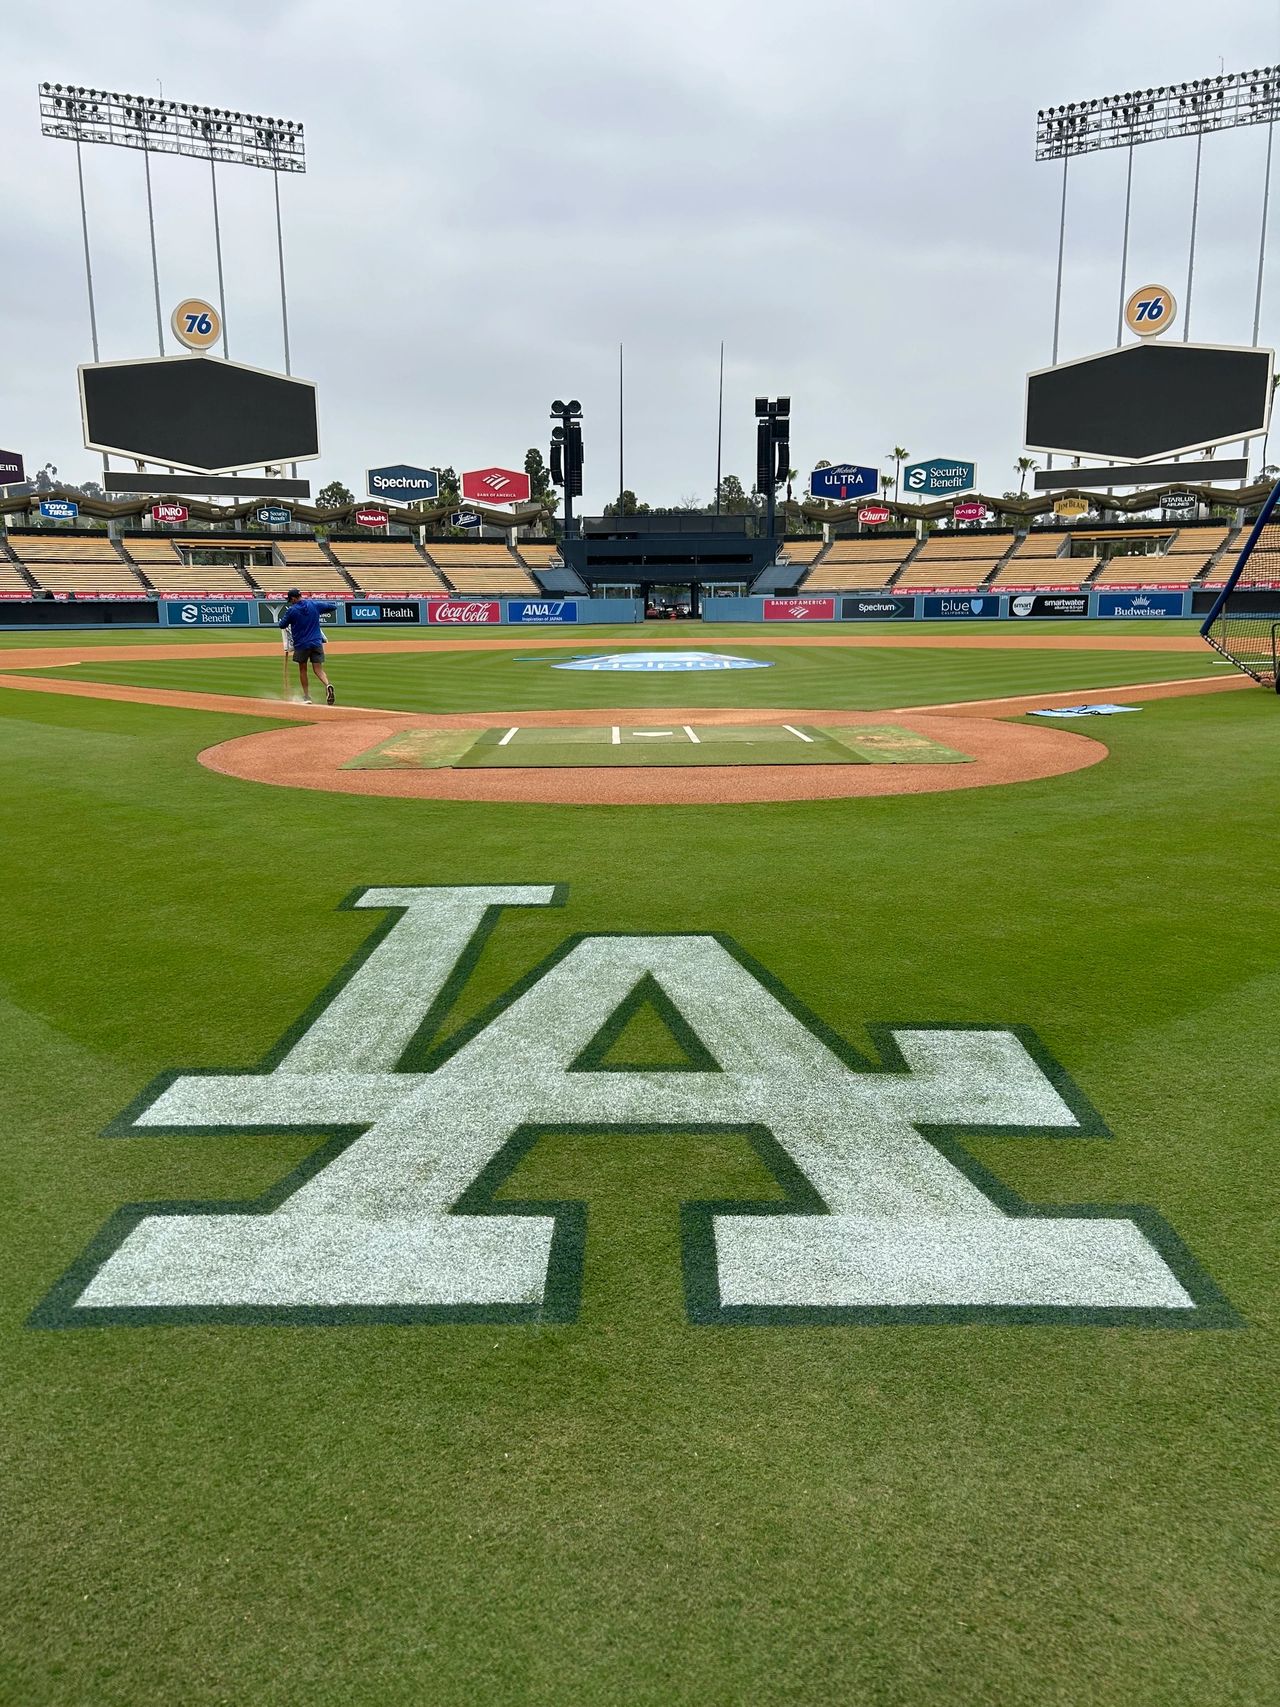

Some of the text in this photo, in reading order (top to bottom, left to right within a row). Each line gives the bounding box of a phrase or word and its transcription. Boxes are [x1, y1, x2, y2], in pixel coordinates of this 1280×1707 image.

[1134, 296, 1164, 322] 76
[183, 312, 213, 335] 76
[930, 466, 969, 478] Security
[373, 476, 430, 489] Spectrum
[824, 474, 864, 485] ULTRA
[930, 478, 963, 488] Benefit
[1161, 496, 1195, 504] STARLUX
[158, 506, 183, 518] JINRO
[1056, 500, 1085, 513] JIM BEAM
[358, 514, 387, 522] Yakult
[859, 510, 889, 521] Churu
[858, 603, 895, 613] Spectrum
[941, 599, 970, 611] blue
[1044, 599, 1086, 607] smartwater
[200, 604, 235, 615] Security
[355, 607, 414, 618] UCLA Health
[435, 602, 492, 622] Coca-Cola
[522, 604, 549, 616] ANA
[1114, 606, 1166, 616] Budweiser
[202, 613, 232, 623] Benefit
[75, 885, 1197, 1309] LA
